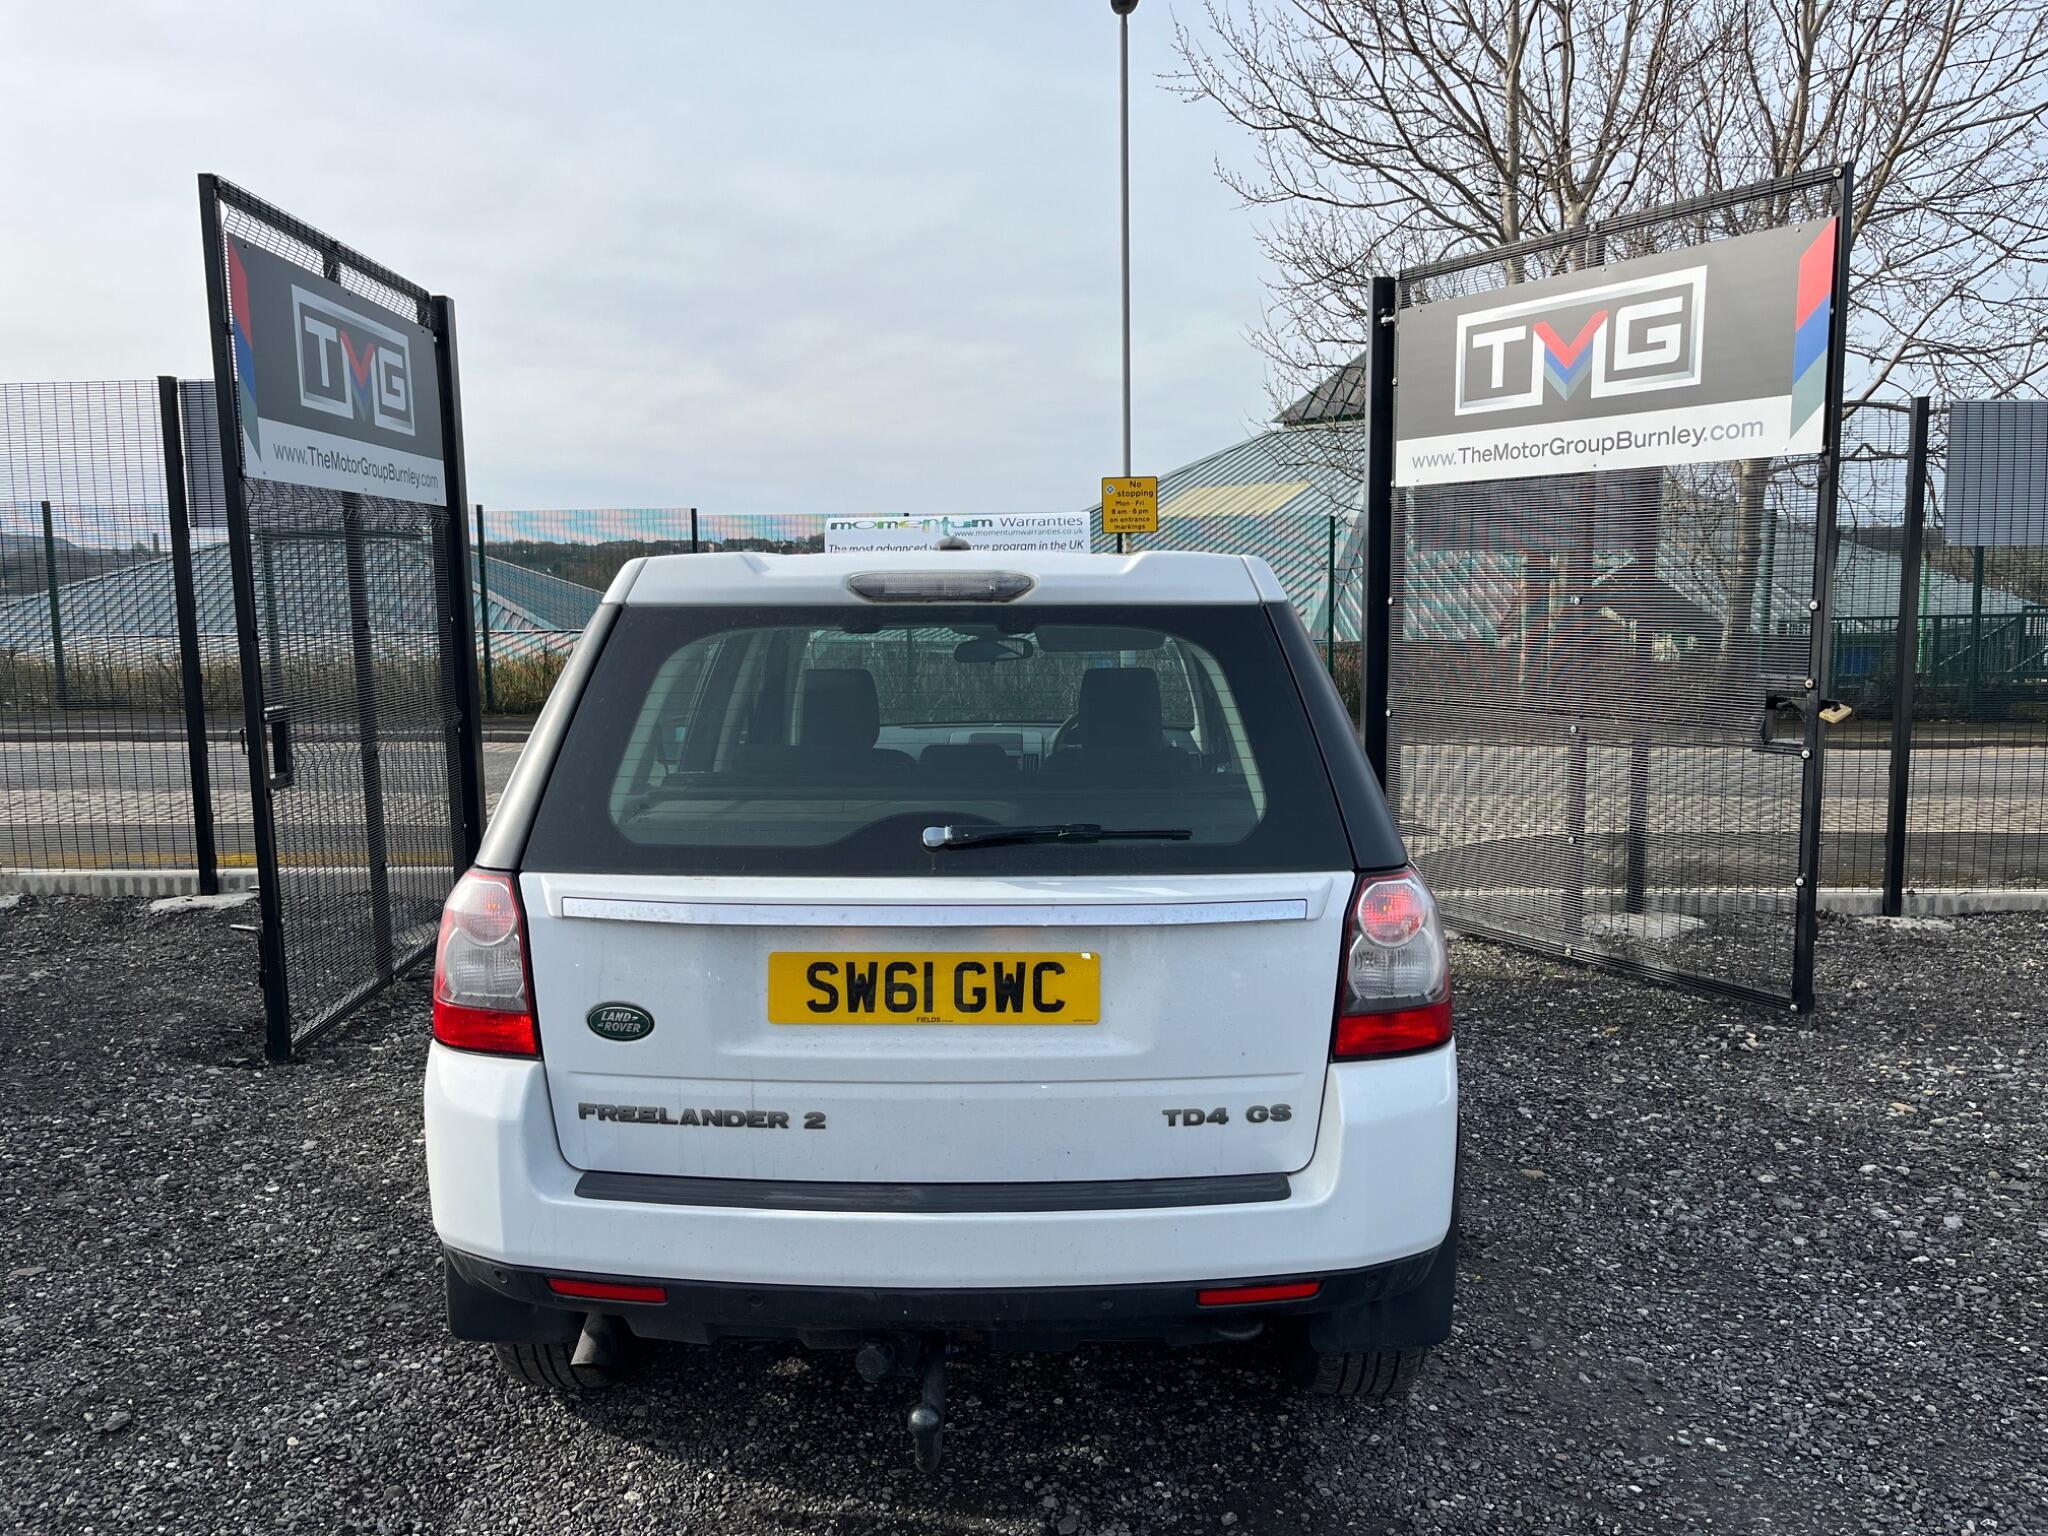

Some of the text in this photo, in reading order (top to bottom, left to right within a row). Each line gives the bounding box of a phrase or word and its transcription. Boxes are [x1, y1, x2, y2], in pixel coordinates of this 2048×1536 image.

[1470, 294, 1686, 405] TMG
[303, 314, 408, 425] TMG
[1411, 420, 1764, 469] www.TheMotorGroupBurnley.com
[273, 443, 439, 489] www.TheMotorGroupBurnley.com
[1117, 490, 1154, 498] stopping
[1129, 480, 1142, 488] No
[830, 516, 1083, 536] momentum Warranties
[954, 528, 1083, 537] www.momentumwarranties.co.uk
[829, 544, 847, 553] The
[876, 544, 928, 552] advanced
[1039, 541, 1051, 551] in
[1052, 540, 1067, 550] the
[1069, 539, 1084, 550] UK
[806, 961, 1066, 1014] SW61 GWC
[578, 1102, 826, 1129] FREELANDER 2
[1162, 1103, 1292, 1127] TD4 GS
